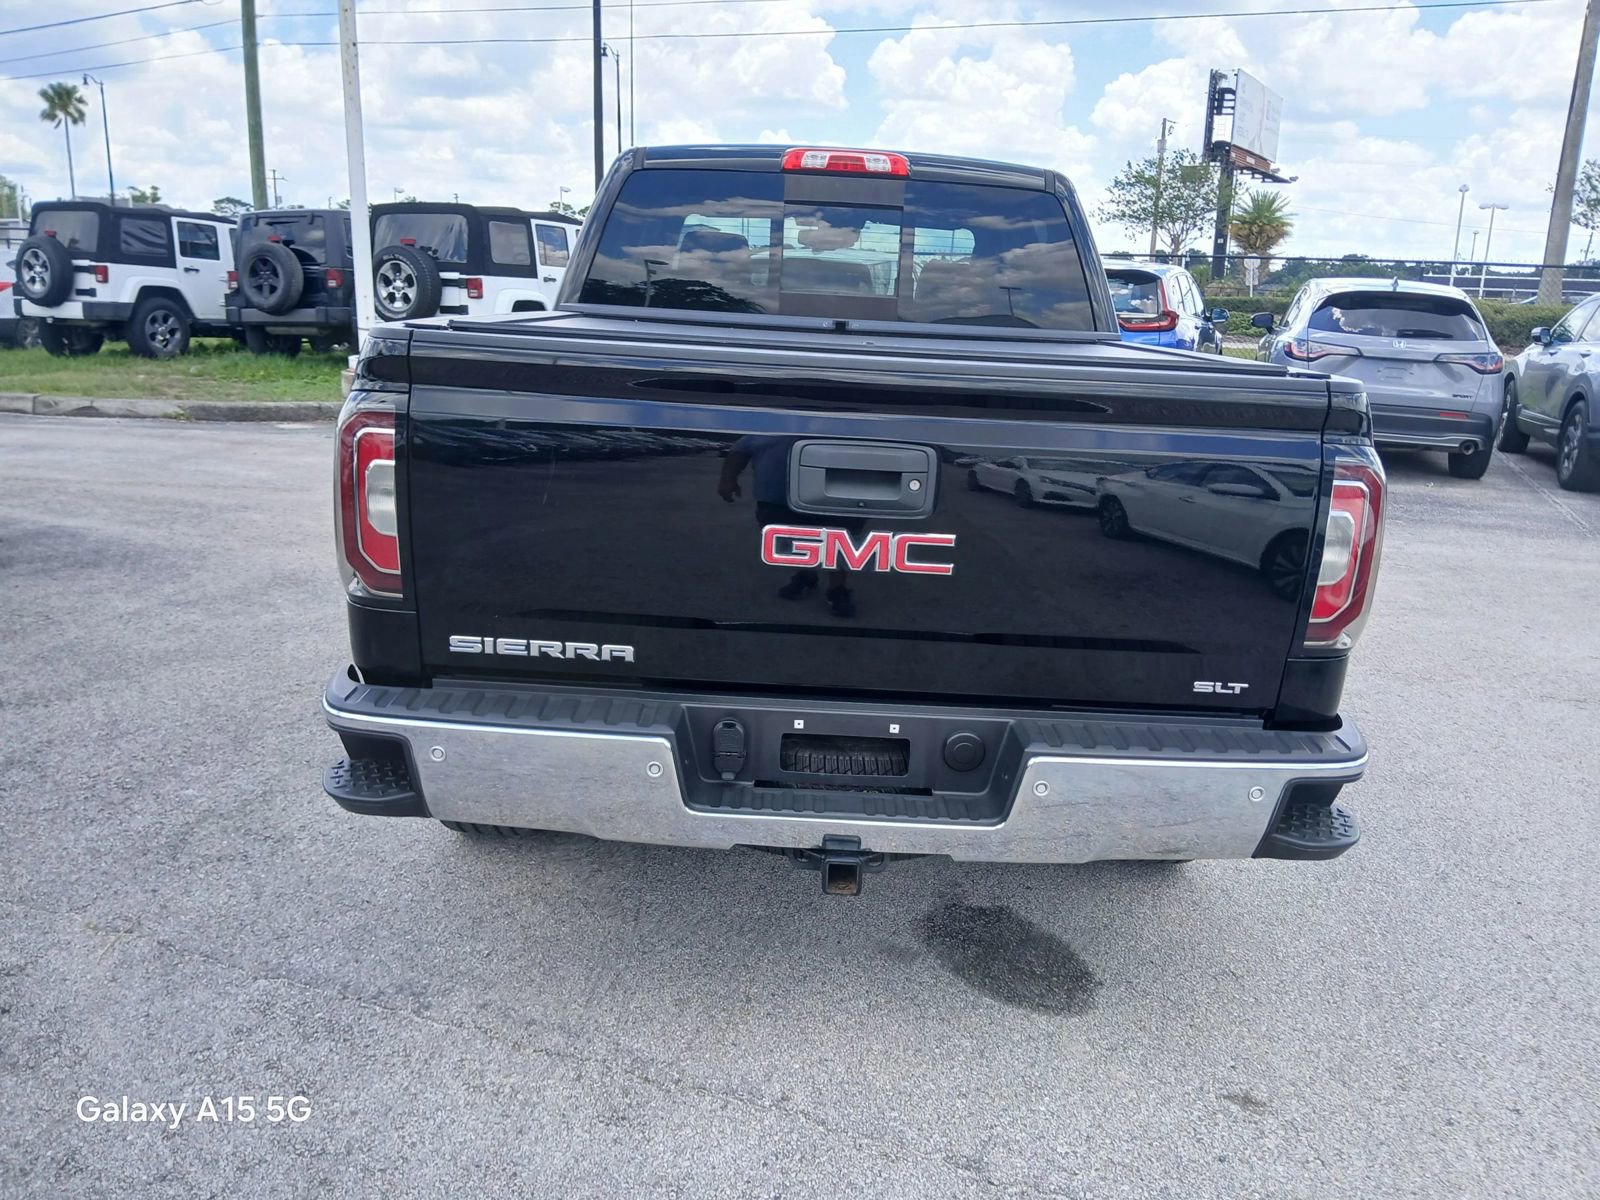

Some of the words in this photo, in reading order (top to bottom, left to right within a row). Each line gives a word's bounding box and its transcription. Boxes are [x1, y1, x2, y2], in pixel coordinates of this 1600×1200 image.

[761, 523, 957, 576] GMC
[449, 635, 636, 663] SIERRA
[1192, 681, 1250, 695] SLT
